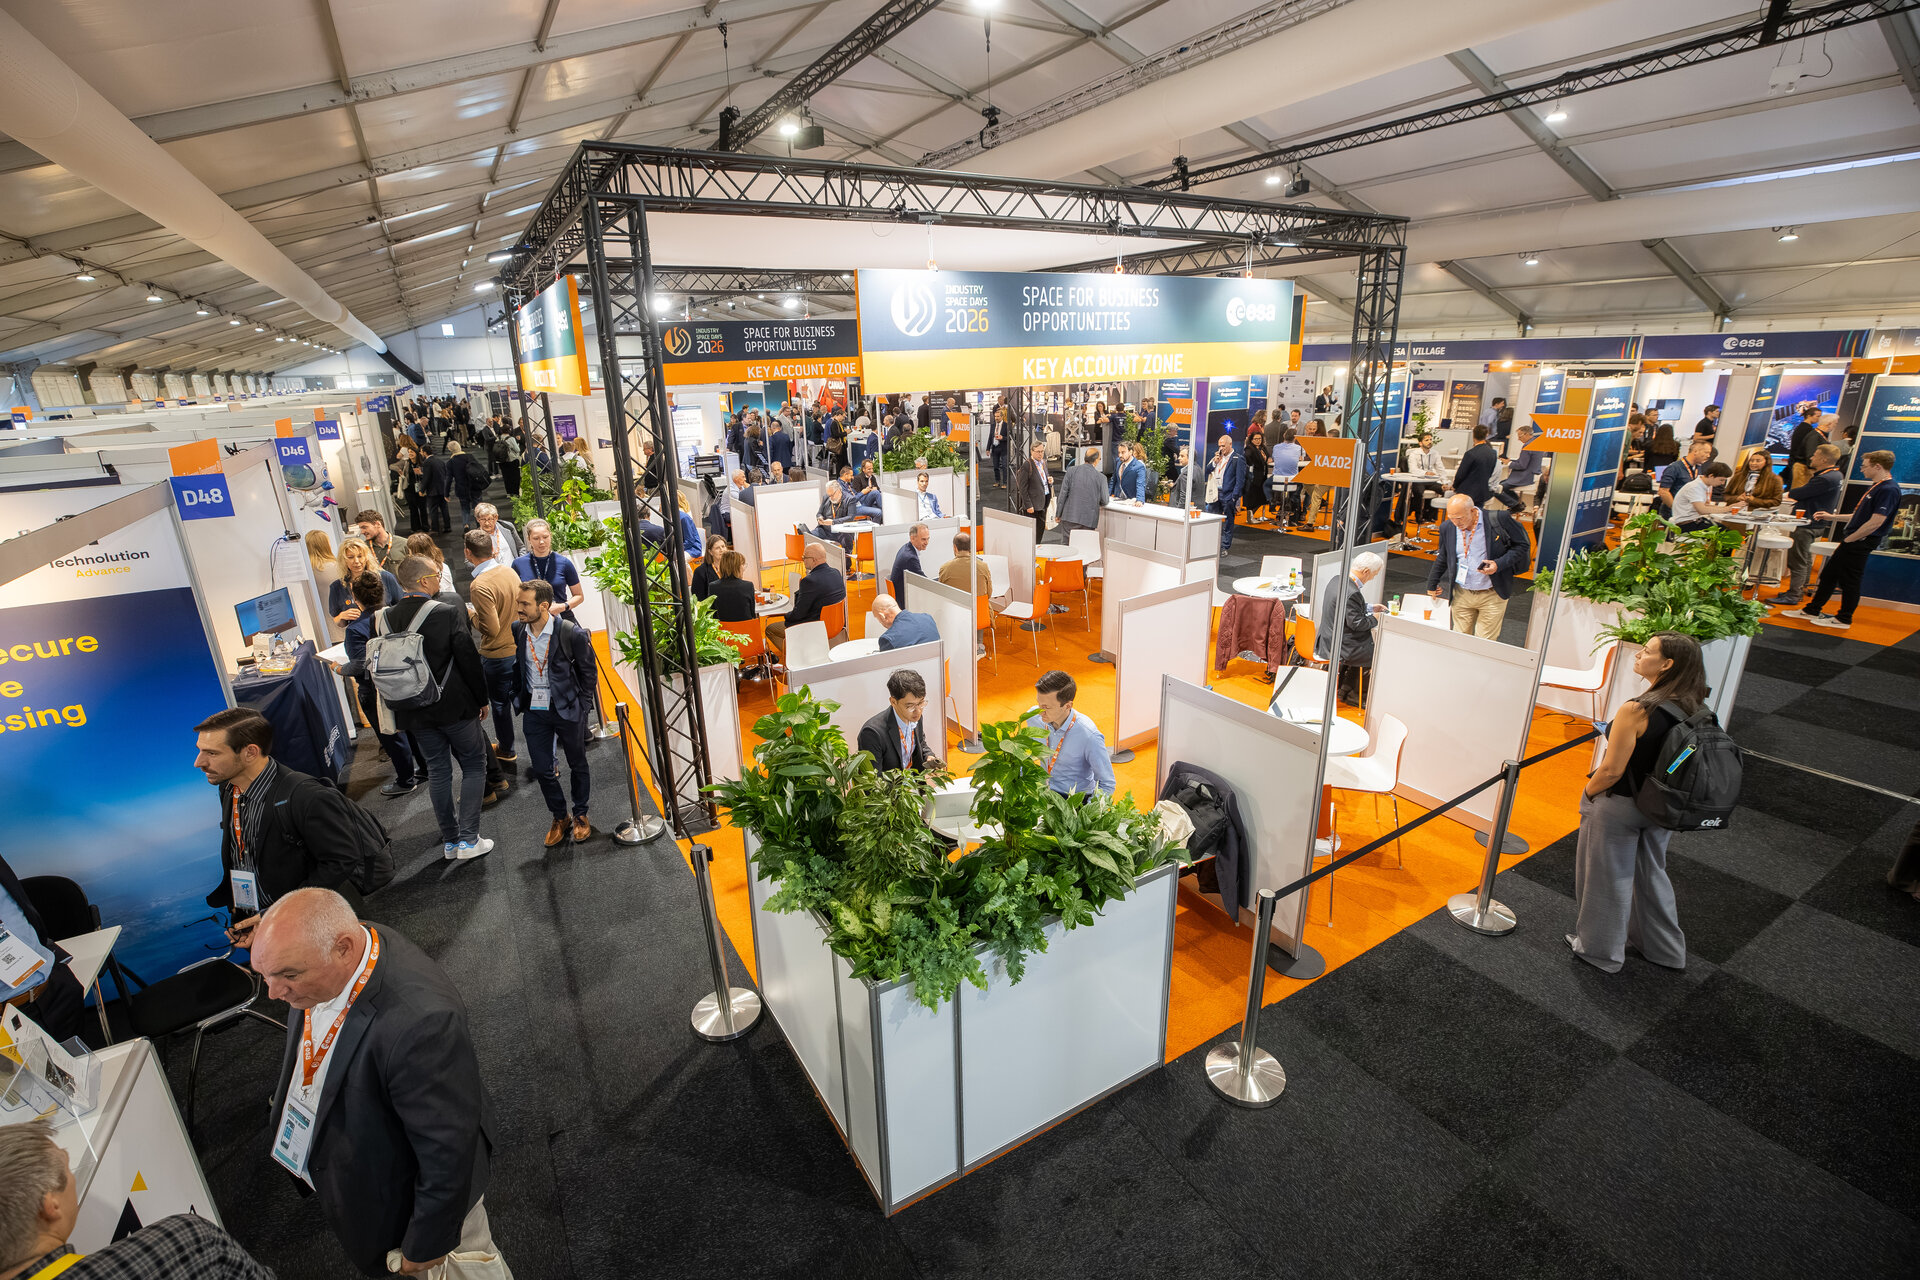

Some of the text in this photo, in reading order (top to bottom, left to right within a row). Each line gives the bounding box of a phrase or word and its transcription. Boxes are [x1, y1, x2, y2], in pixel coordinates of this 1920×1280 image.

[945, 285, 984, 295] INDUSTRY
[1022, 286, 1160, 307] SPACE FOR BUSINESS
[945, 297, 988, 306] SPACE DAYS
[945, 308, 989, 333] 2026
[1022, 311, 1131, 332] OPPORTUNITIES
[744, 326, 835, 339] SPACE FOR BUSINESS
[697, 340, 724, 354] 2026
[745, 340, 817, 353] OPPORTUNITIES
[1739, 339, 1765, 348] esa
[1412, 346, 1446, 356] VILLAGE
[747, 362, 857, 379] KEY ACCOUNT ZONE
[1022, 353, 1184, 380] KEY ACCOUNT ZONE
[319, 426, 337, 435] D44
[1545, 428, 1582, 440] KAZ03
[281, 445, 305, 457] D46
[1314, 454, 1351, 469] KAZ02
[182, 487, 224, 507] D48
[76, 565, 131, 578] Advance
